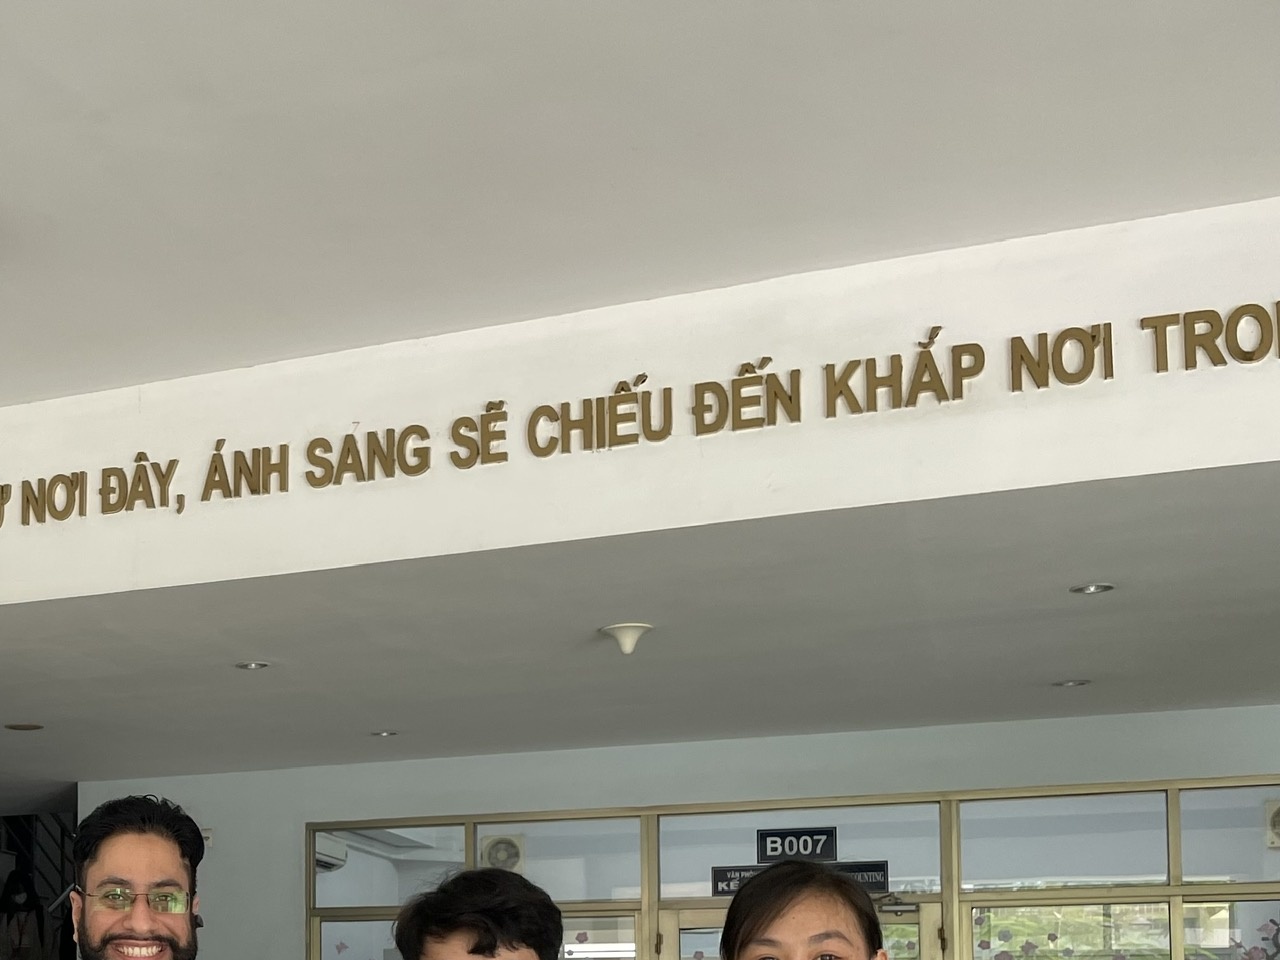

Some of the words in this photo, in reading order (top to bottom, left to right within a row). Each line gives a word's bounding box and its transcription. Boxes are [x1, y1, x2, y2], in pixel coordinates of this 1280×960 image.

[21, 470, 88, 526] NƠI
[98, 451, 186, 515] ĐÂY,
[201, 438, 290, 503] ÁNH
[449, 400, 509, 470] SẼ
[527, 372, 673, 459] CHIẾU
[691, 356, 802, 437] ĐẾN
[823, 325, 986, 420] KHẮP
[1010, 321, 1114, 393] NƠI
[1140, 300, 1280, 374] TRO
[766, 835, 828, 856] B007
